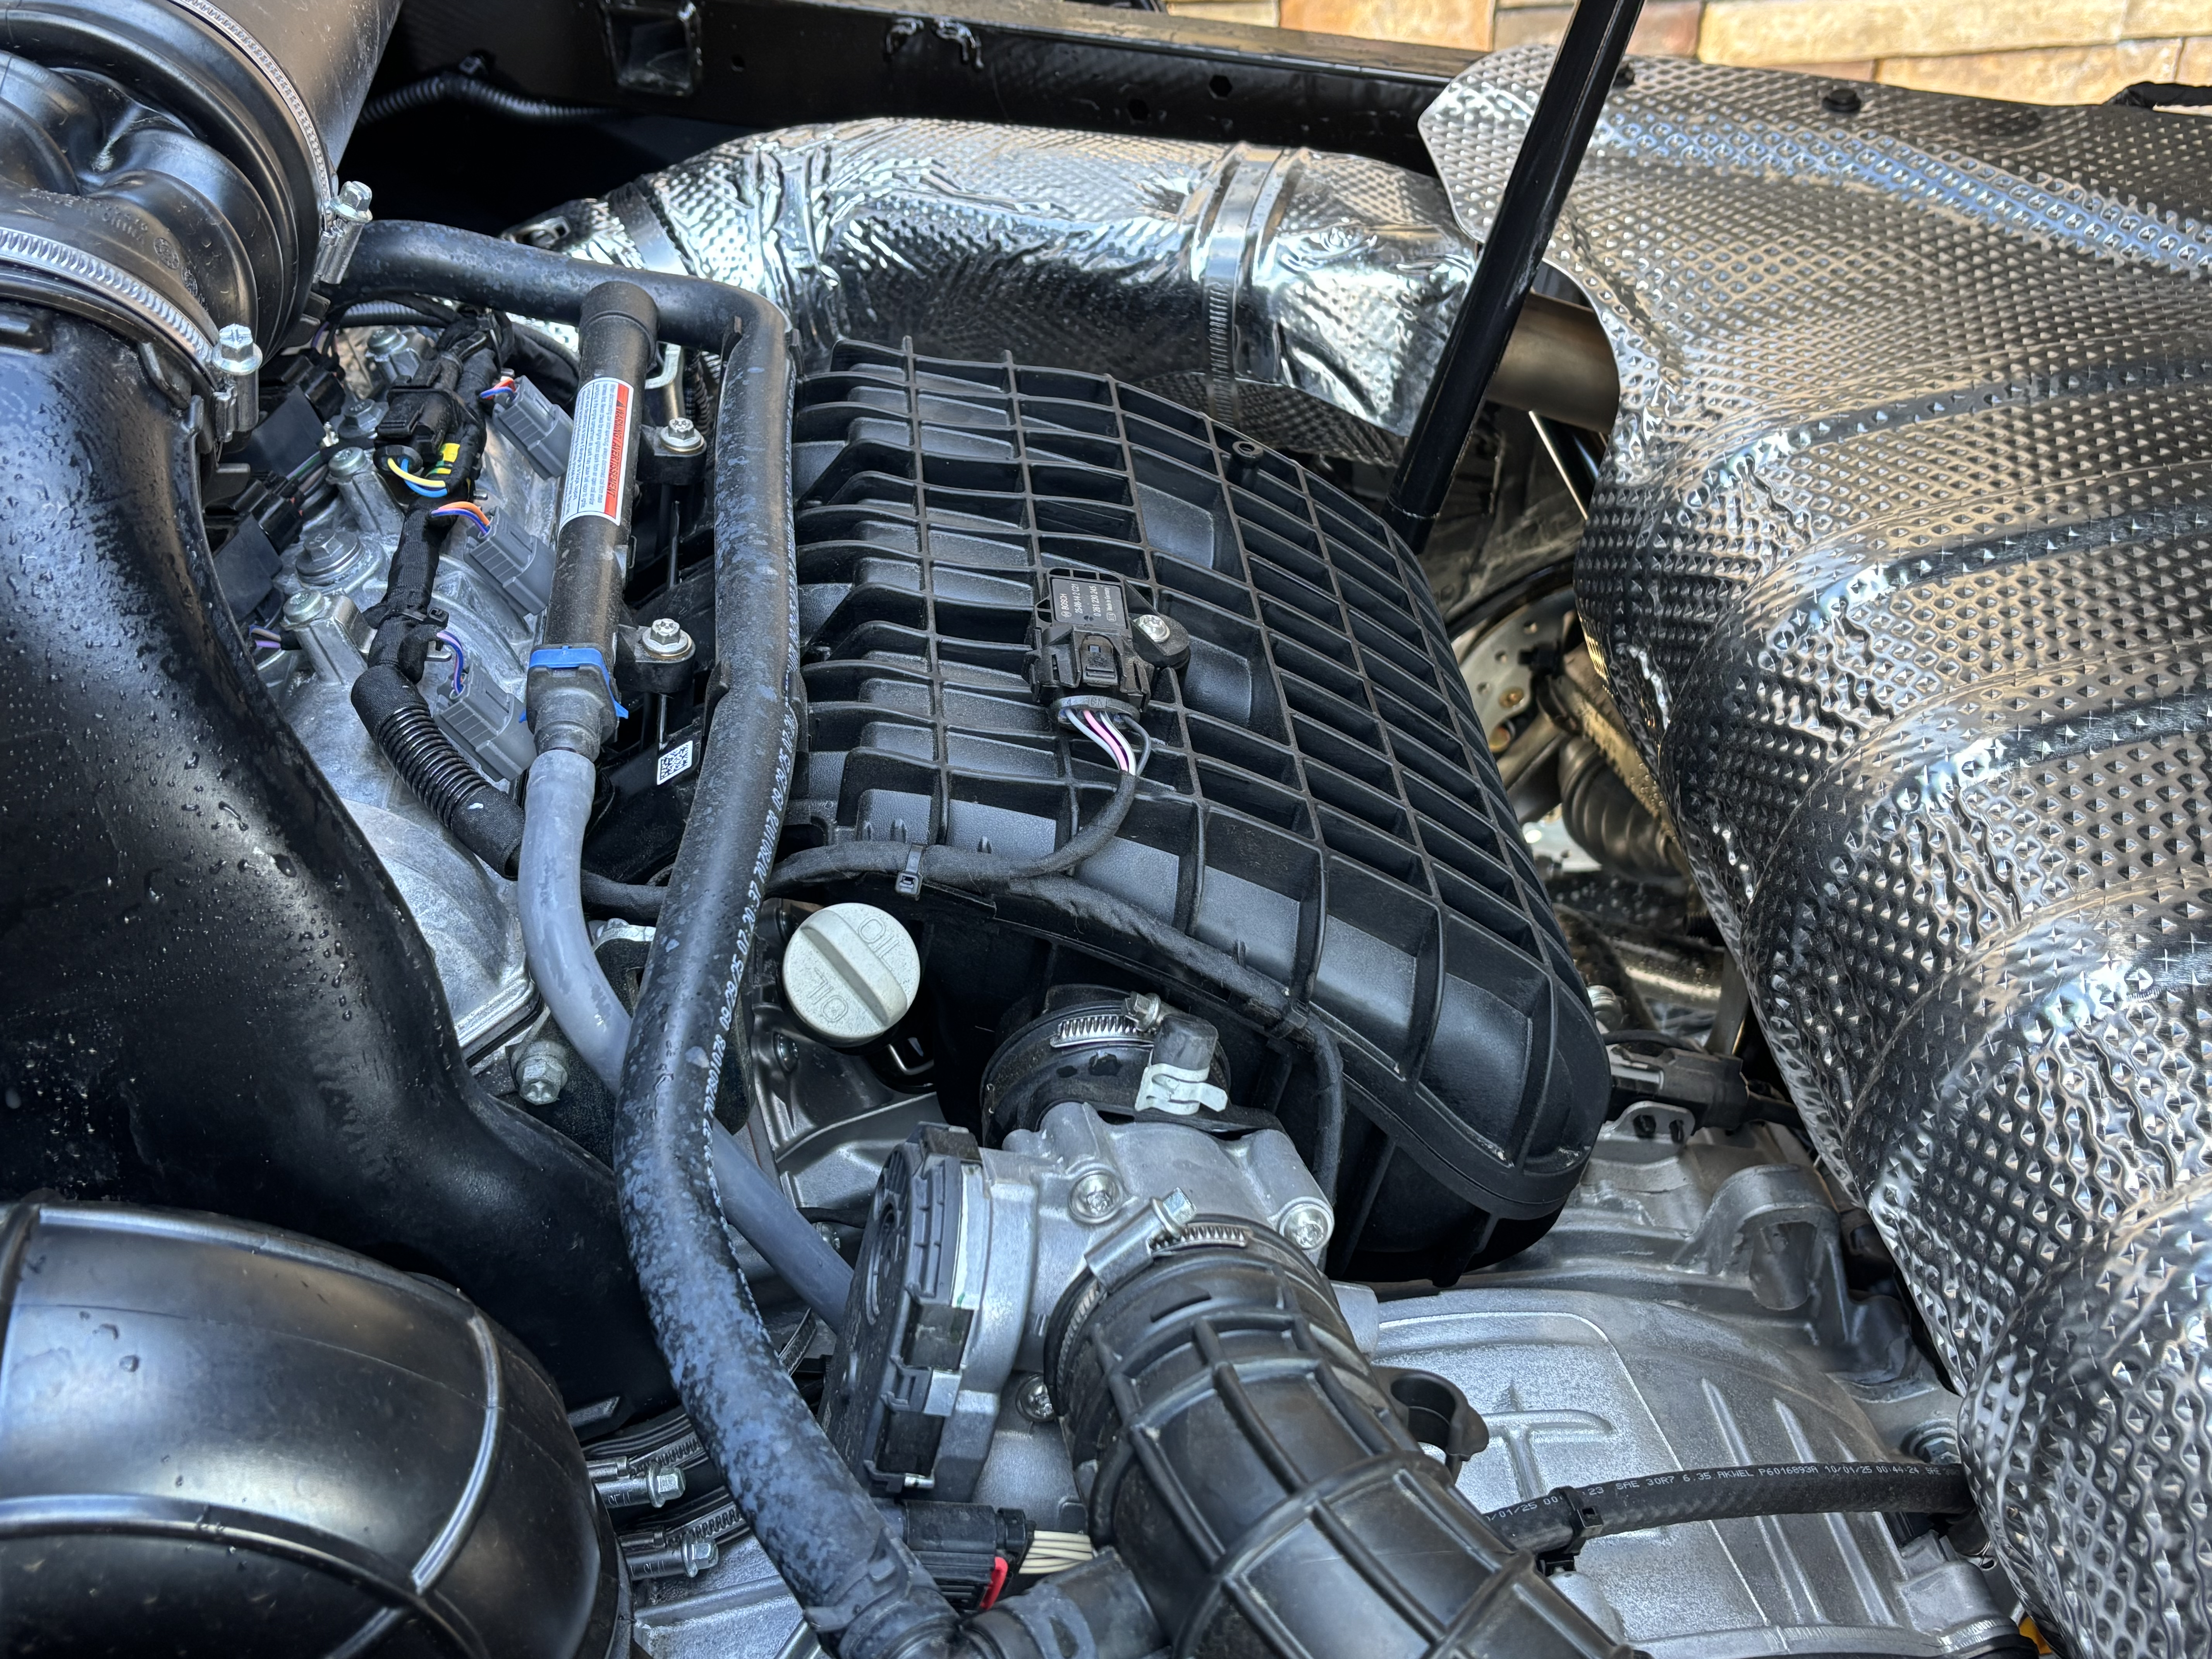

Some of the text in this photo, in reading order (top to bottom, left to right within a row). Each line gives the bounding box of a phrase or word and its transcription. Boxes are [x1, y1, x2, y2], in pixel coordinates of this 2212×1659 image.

[613, 408, 624, 438] WARNING
[606, 442, 620, 498] AVERTISSEMENT
[1060, 593, 1069, 610] BOSCH
[1089, 586, 1097, 594] 245
[1092, 604, 1101, 613] 261
[703, 1034, 726, 1118] 707801078
[719, 954, 744, 1031] 09/29/25
[737, 880, 761, 955] 07:20:37
[753, 809, 779, 884] 707801078
[771, 748, 791, 811] 09/29/25
[857, 915, 900, 972] OIL
[807, 967, 849, 1022] OIL
[1615, 1480, 1640, 1491] SAE
[1647, 1476, 1675, 1486] 30R7
[1718, 1469, 1754, 1479] AKWEL
[1758, 1466, 1819, 1476] P6016893A
[1824, 1465, 1872, 1474] 10/01/25
[1876, 1466, 1920, 1474] 00:44:24
